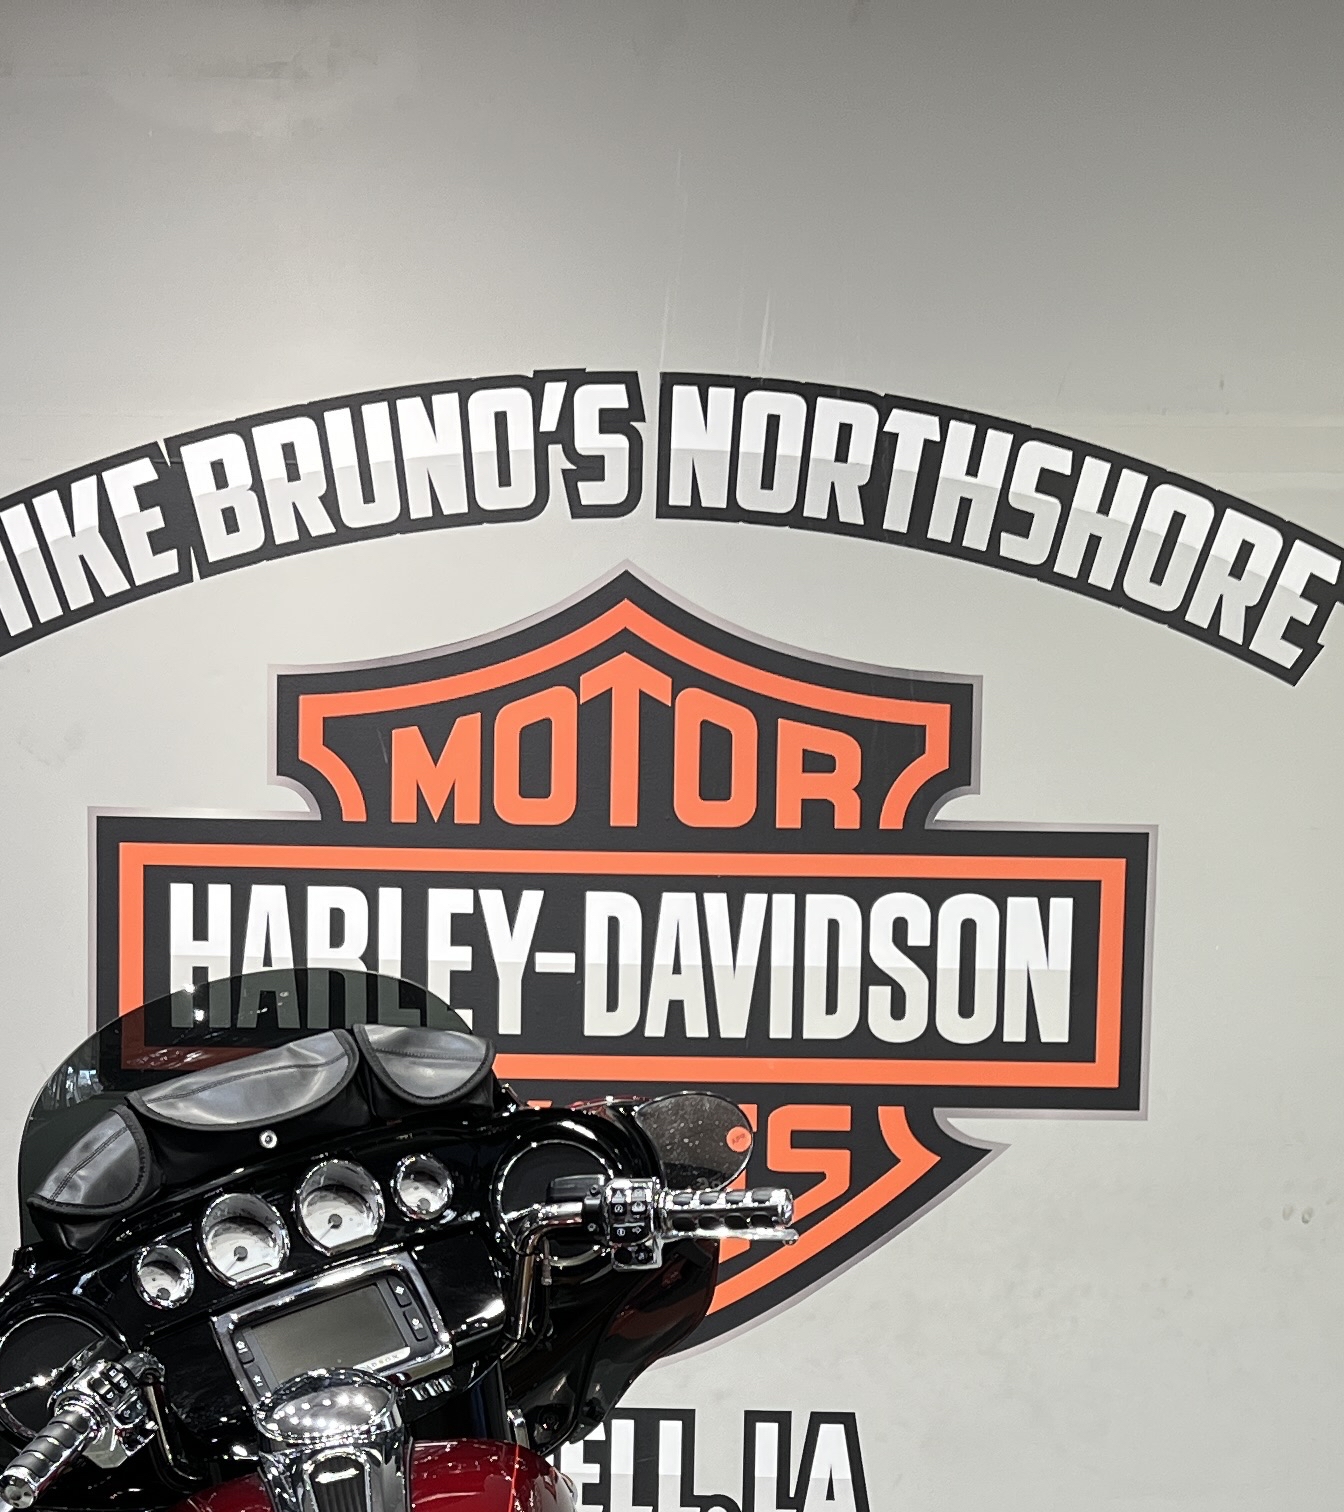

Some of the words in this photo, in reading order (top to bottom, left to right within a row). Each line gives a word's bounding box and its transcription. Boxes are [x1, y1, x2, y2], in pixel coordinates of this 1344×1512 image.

[179, 380, 632, 564] BRUNO'S
[668, 384, 1343, 671] NORTHSHORE
[390, 651, 862, 830] MOTOR
[169, 882, 1074, 1045] HARLEY-DAVIDSON
